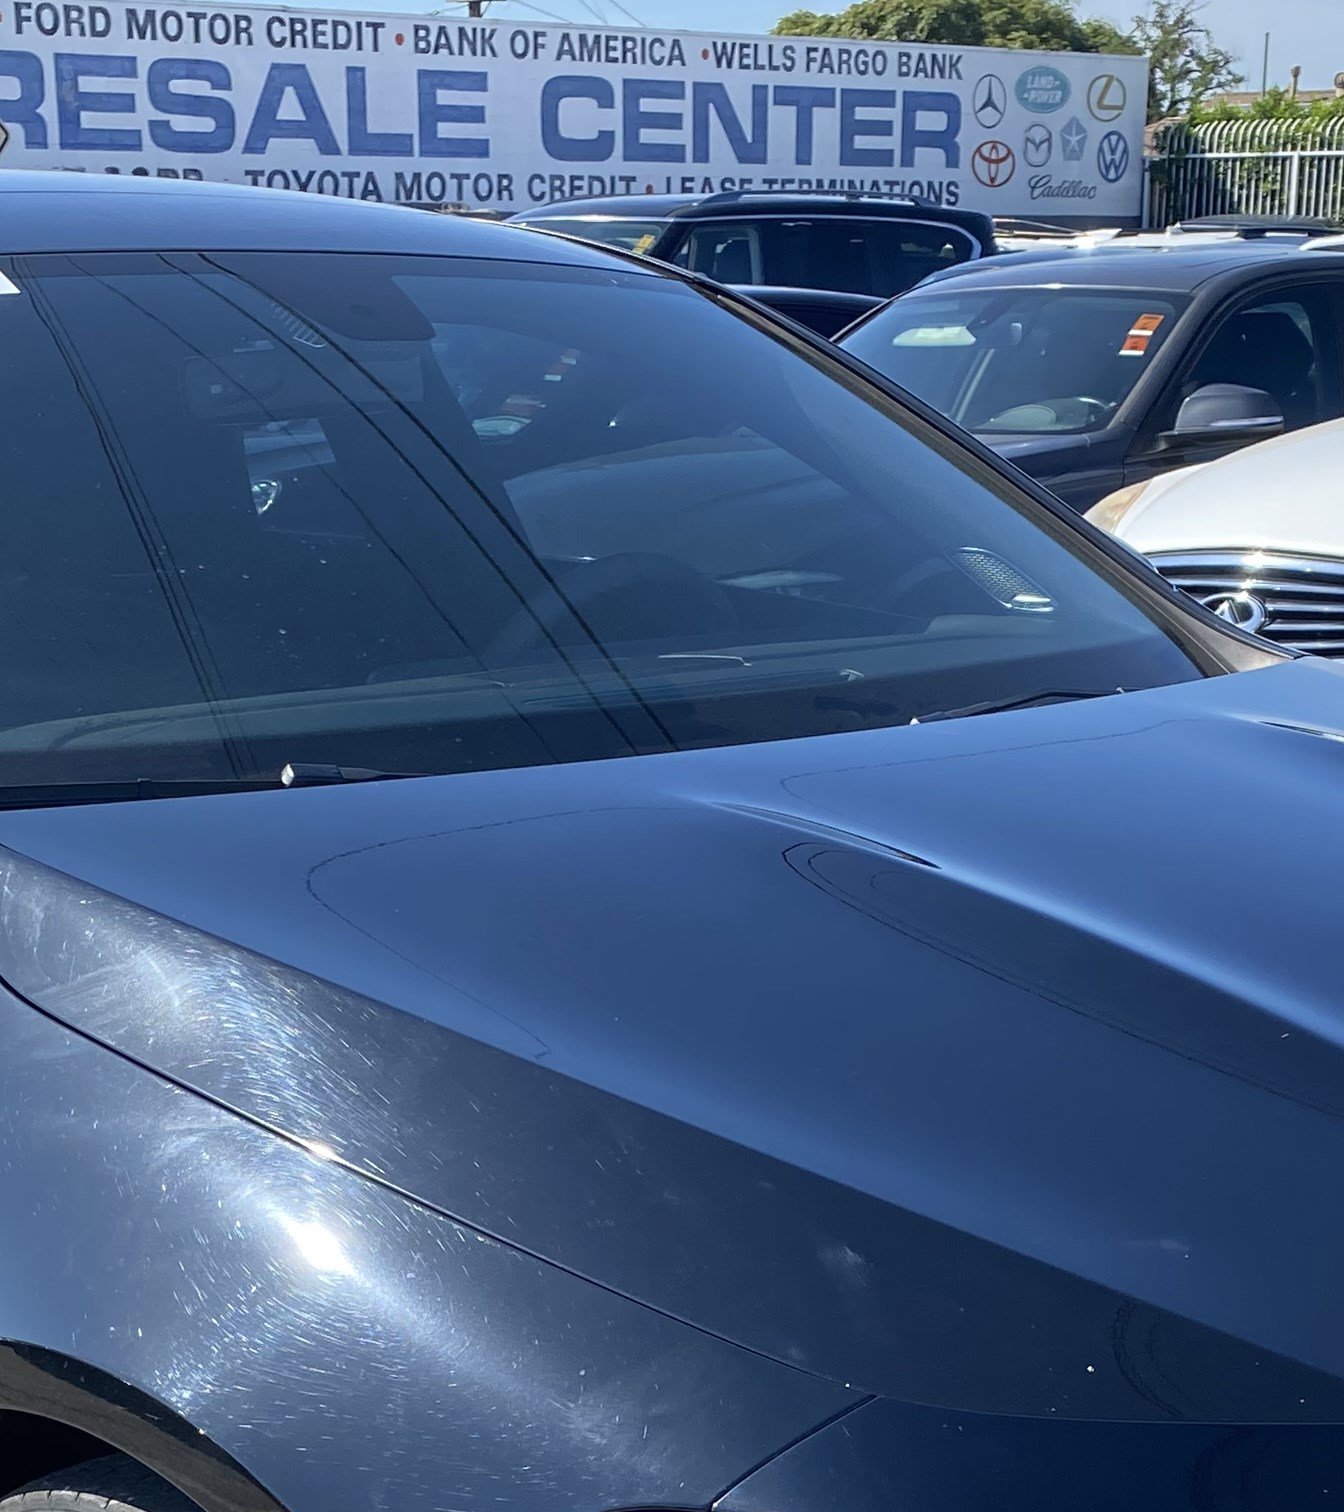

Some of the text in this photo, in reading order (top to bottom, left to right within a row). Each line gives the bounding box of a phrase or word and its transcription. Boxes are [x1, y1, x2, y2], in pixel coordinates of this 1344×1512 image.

[14, 11, 111, 40] FORD
[125, 15, 254, 48] MOTOR
[265, 17, 385, 53] CREDIT
[413, 25, 497, 59] BANK
[508, 30, 545, 60] OF
[554, 34, 686, 68] AMERICA
[711, 40, 796, 72] WELLS
[805, 46, 888, 77] FARGO
[897, 51, 963, 80] BANK
[539, 73, 961, 169] CENTER
[394, 172, 514, 203] MOTOR
[527, 173, 637, 201] CREDIT
[1028, 174, 1097, 200] Cadillac
